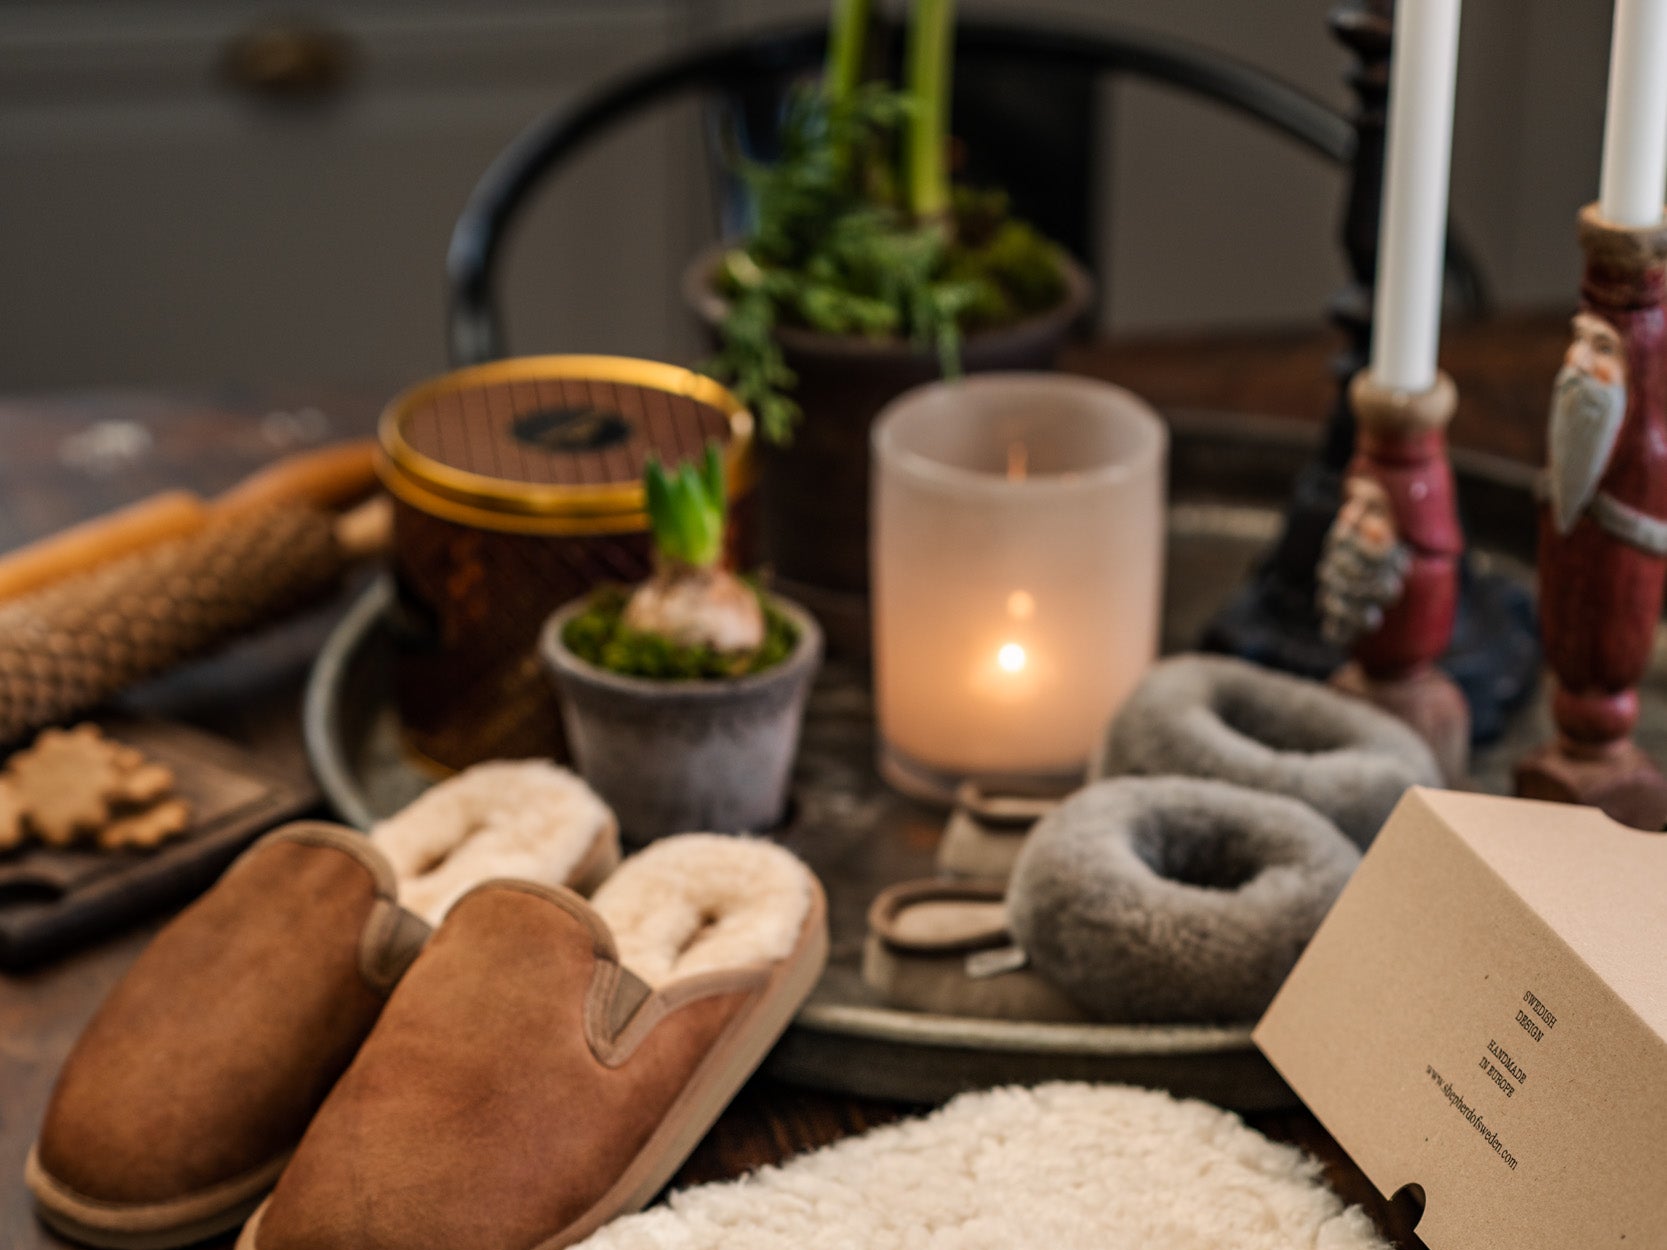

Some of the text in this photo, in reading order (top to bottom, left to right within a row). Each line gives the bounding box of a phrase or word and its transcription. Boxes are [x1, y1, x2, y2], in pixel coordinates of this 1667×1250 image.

[1515, 1009, 1544, 1042] DESIGN
[1523, 990, 1557, 1029] SWEDISH
[1479, 1056, 1515, 1098] IN EUROPE
[1487, 1039, 1527, 1085] HANDMADE
[1426, 1064, 1518, 1170] www.shepherdofsweden.com
